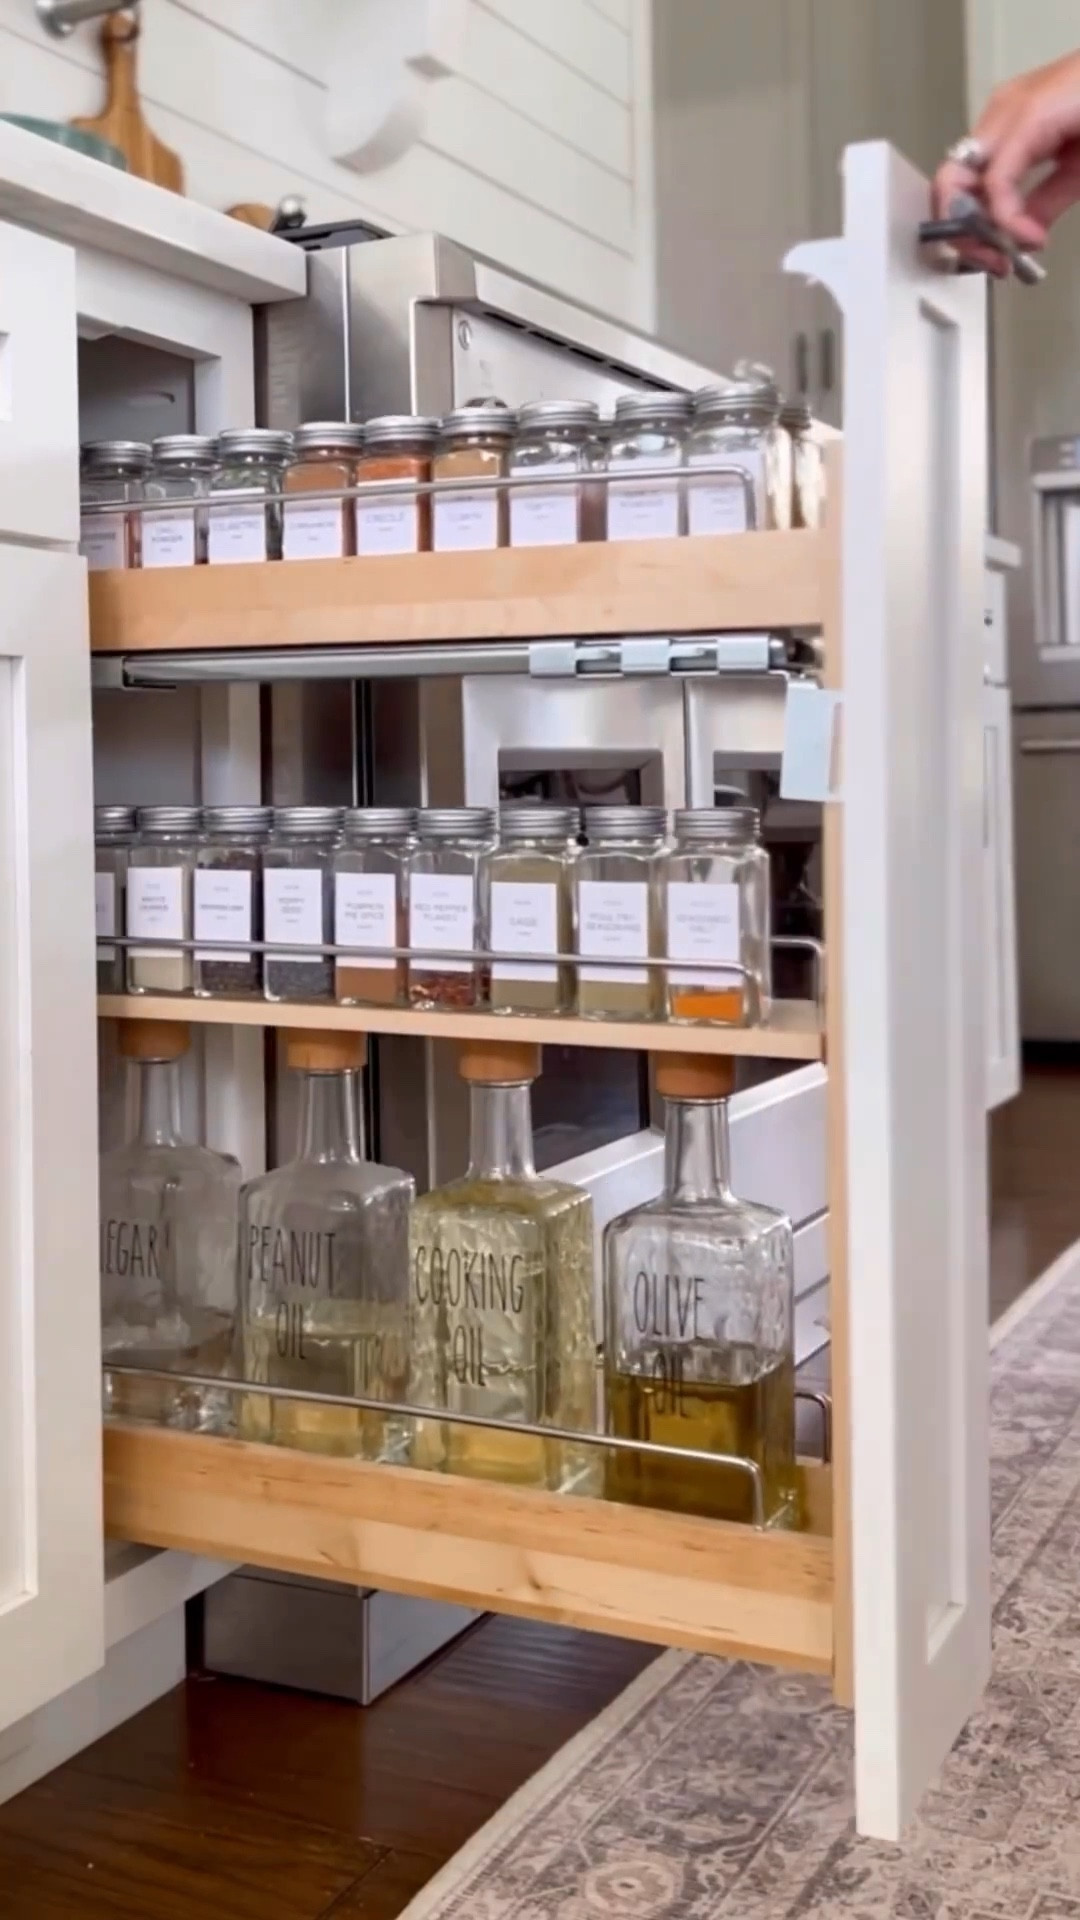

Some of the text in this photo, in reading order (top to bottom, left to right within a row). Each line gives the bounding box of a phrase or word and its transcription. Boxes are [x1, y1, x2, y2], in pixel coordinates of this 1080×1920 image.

[248, 1224, 336, 1299] PEANUT
[414, 1245, 524, 1315] COOKING
[275, 1302, 306, 1360] OIL
[633, 1271, 705, 1337] OLIVE
[452, 1325, 486, 1387] OIL
[652, 1350, 689, 1418] OIL
